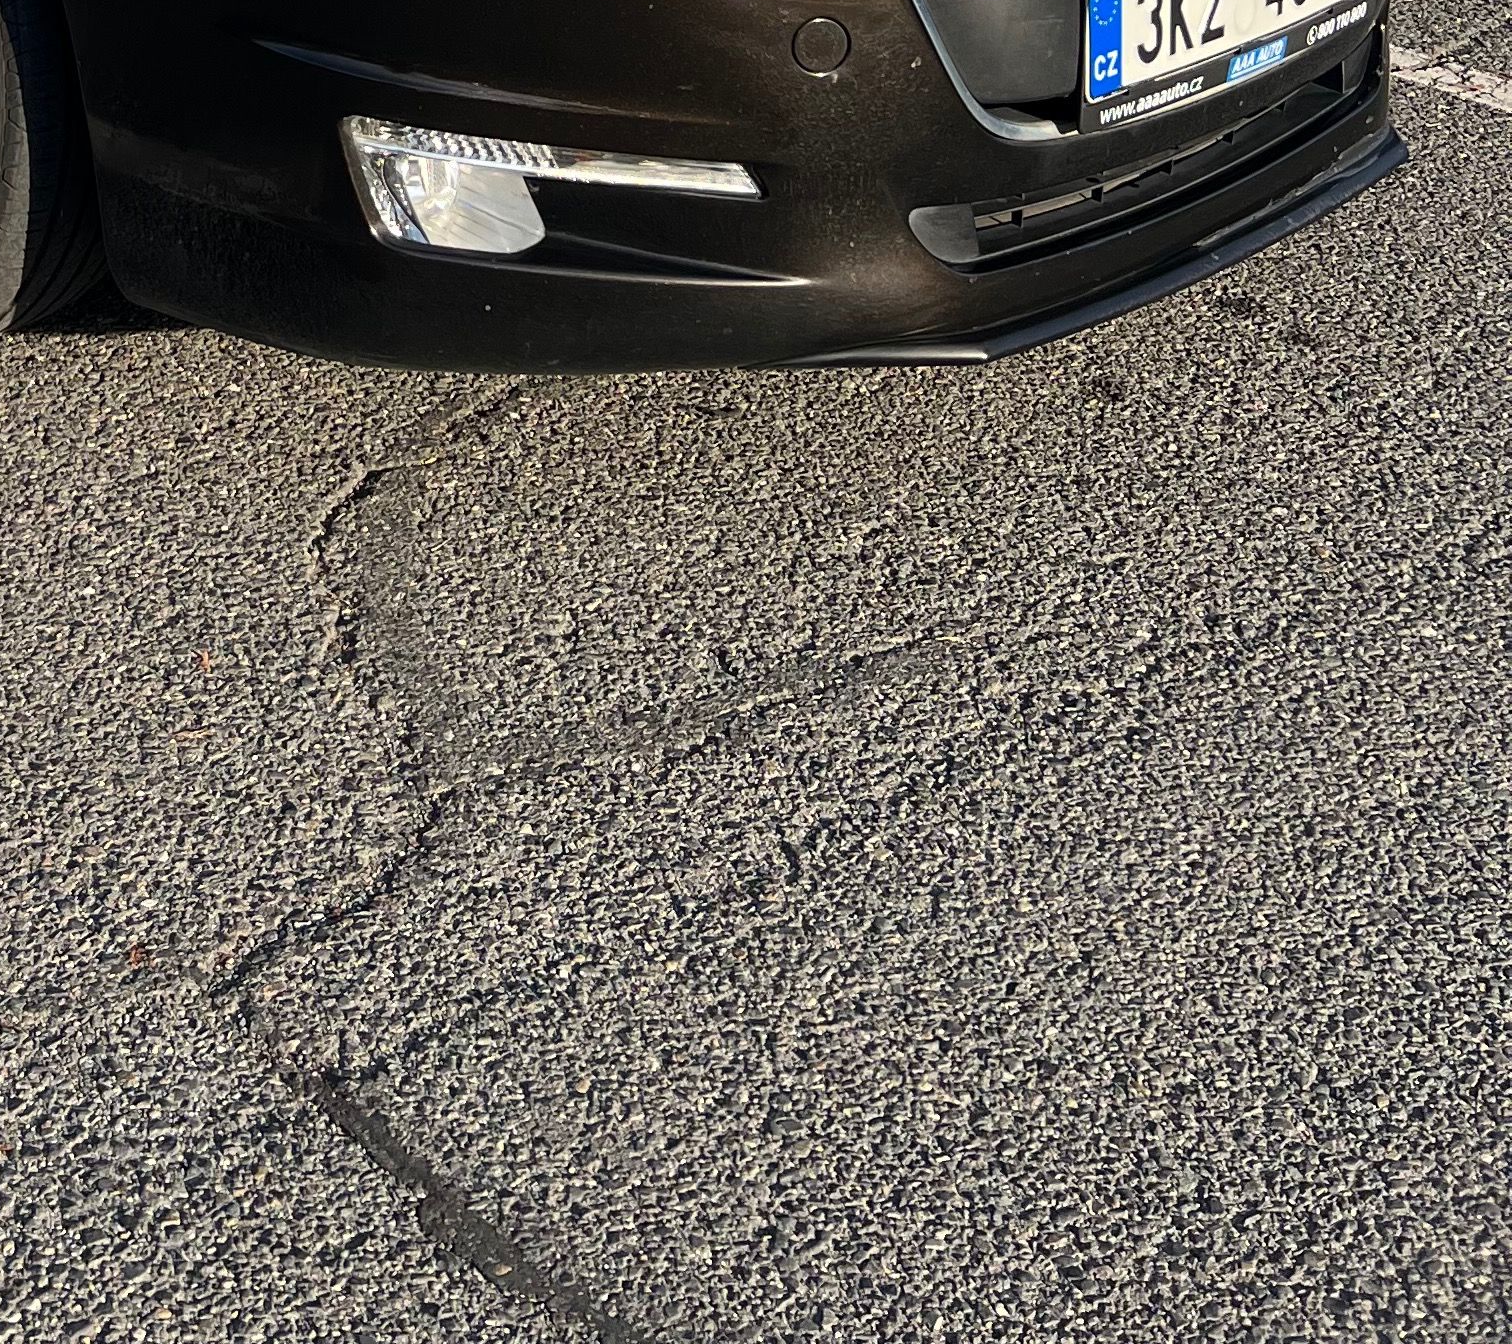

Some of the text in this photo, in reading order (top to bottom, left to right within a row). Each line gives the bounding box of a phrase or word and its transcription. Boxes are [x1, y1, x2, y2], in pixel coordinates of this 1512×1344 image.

[1094, 49, 1119, 81] CZ
[1232, 39, 1285, 72] AAA AUTO
[1099, 76, 1205, 124] www.aaaauto.cz
